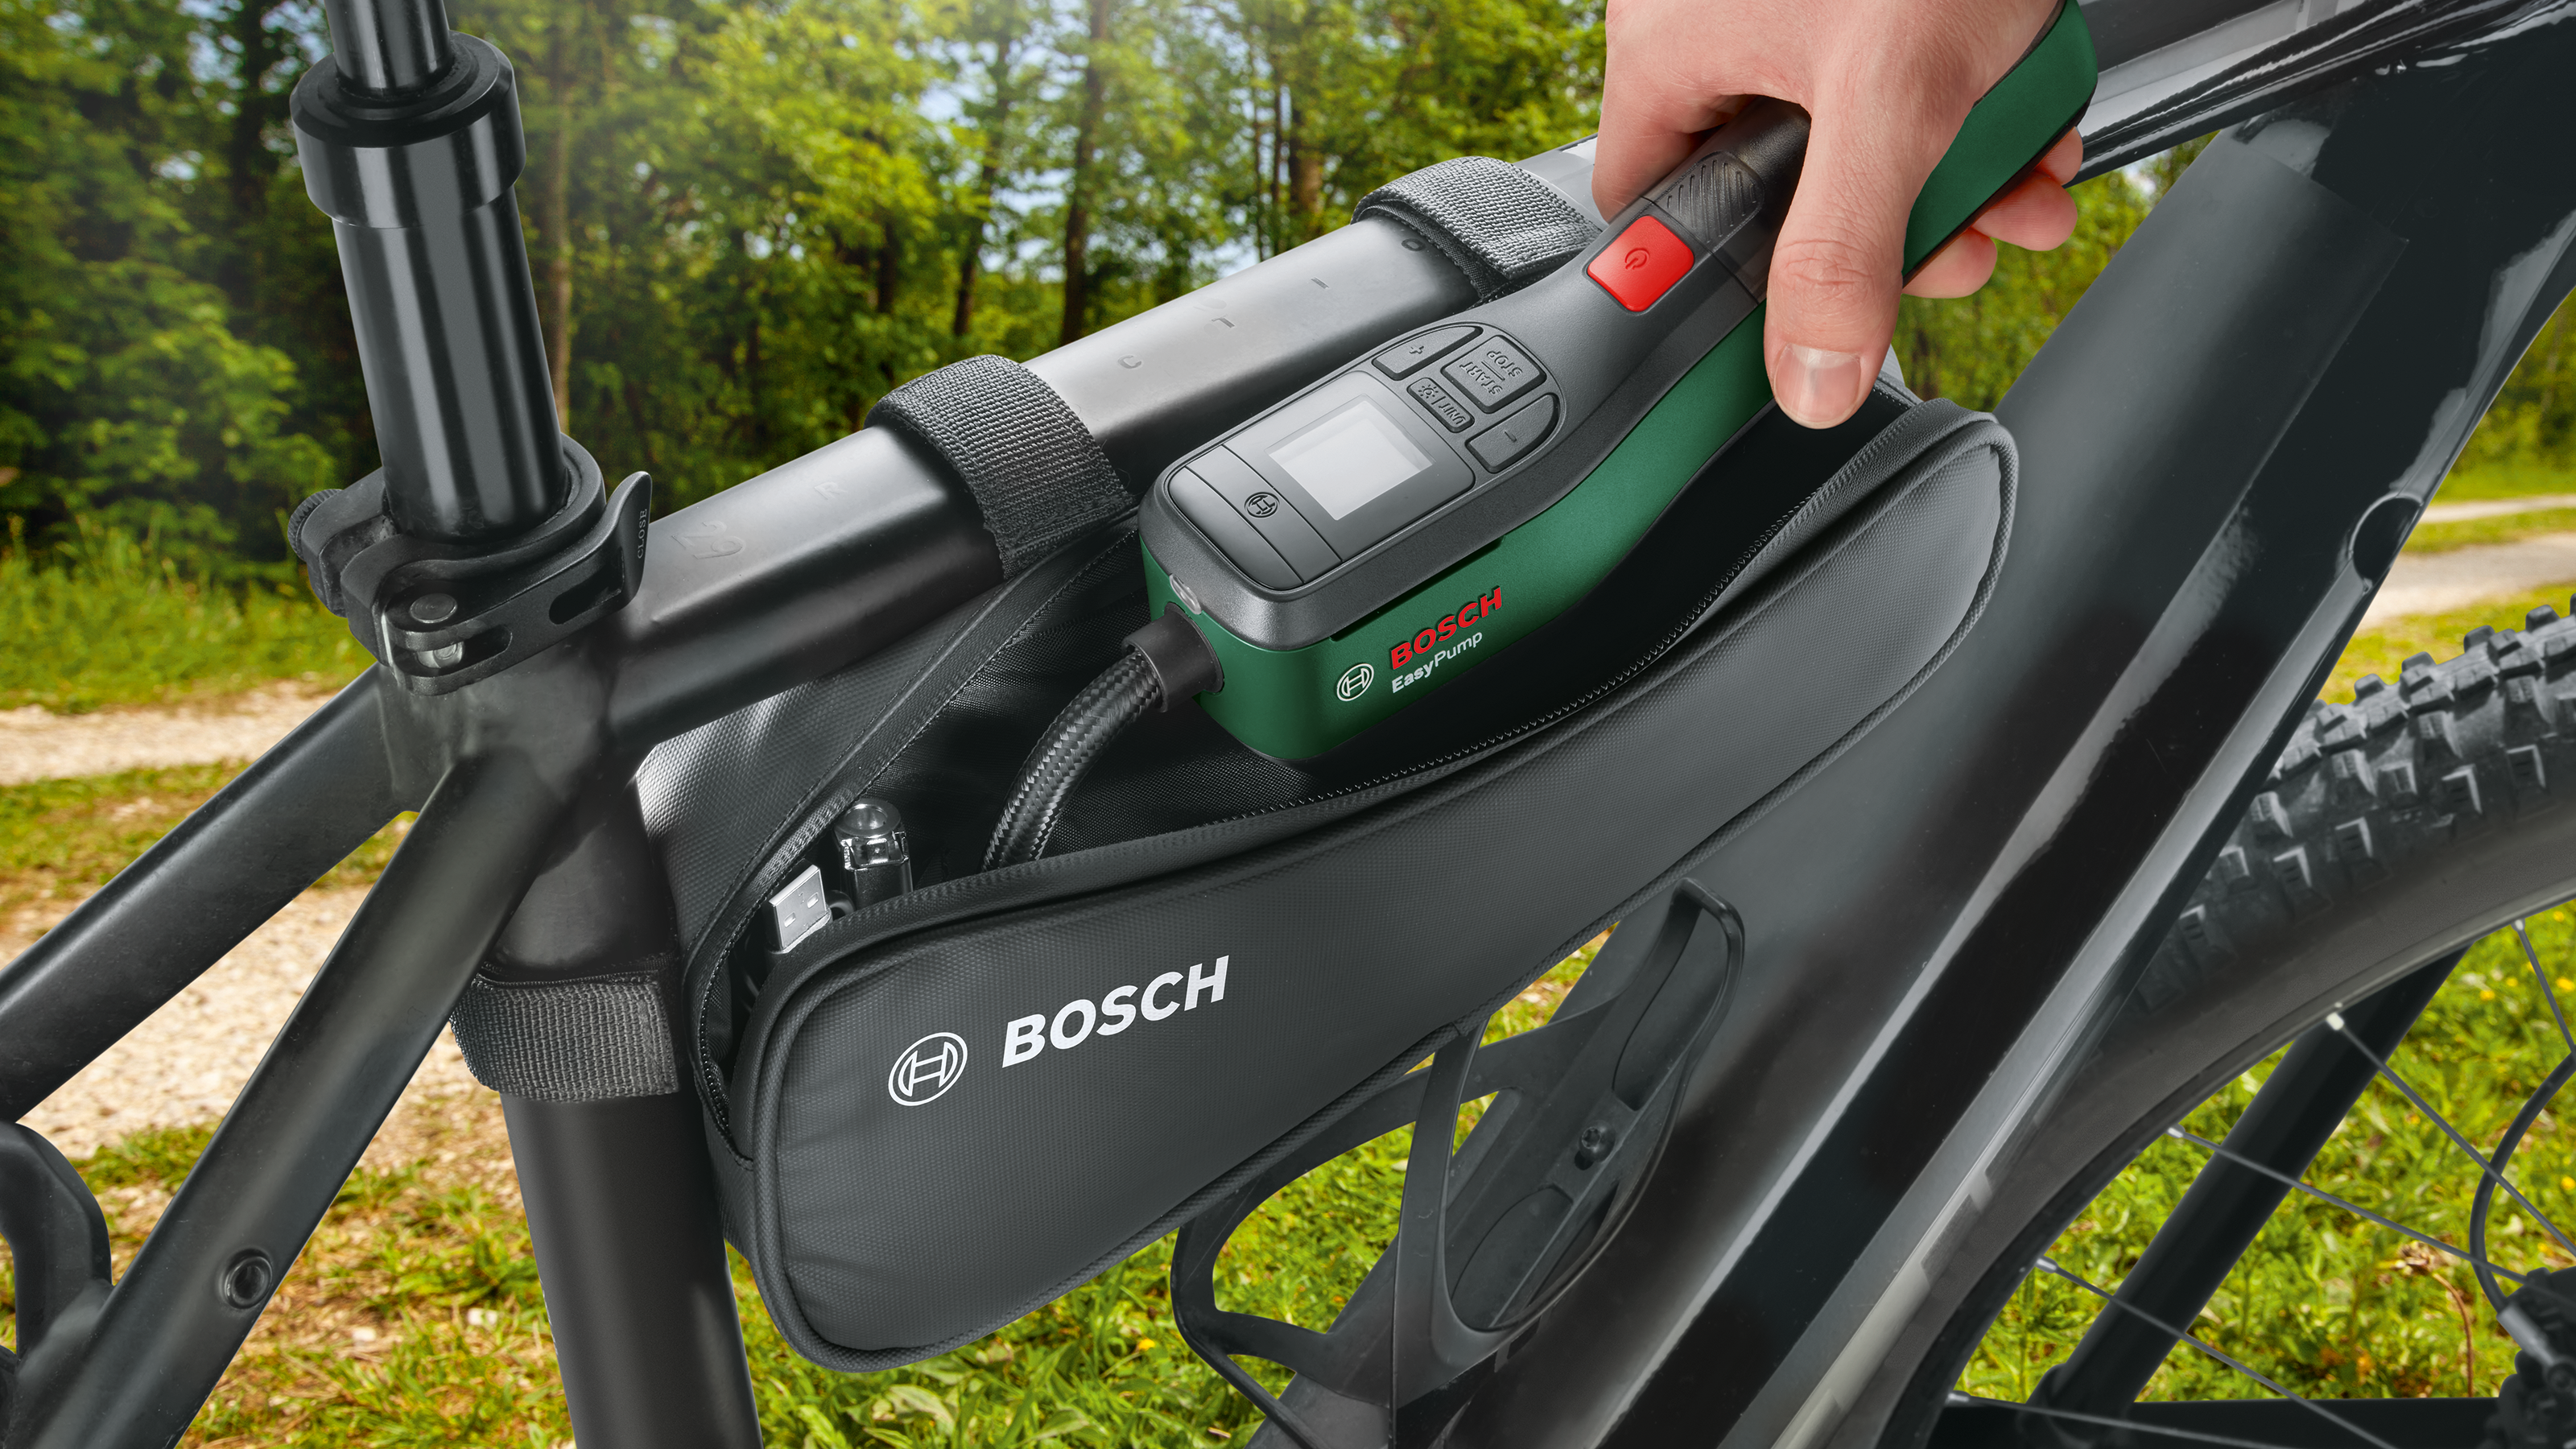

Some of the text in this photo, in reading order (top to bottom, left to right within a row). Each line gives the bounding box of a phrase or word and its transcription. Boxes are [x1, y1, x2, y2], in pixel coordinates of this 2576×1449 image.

[1460, 361, 1503, 394] START
[1486, 350, 1523, 378] STOP
[1439, 402, 1466, 426] UNIT
[637, 508, 647, 559] CLOSE
[671, 520, 746, 560] 29
[1389, 585, 1502, 670] BOSCH
[1391, 632, 1483, 693] EasyPump
[1002, 955, 1229, 1068] BOSCH
